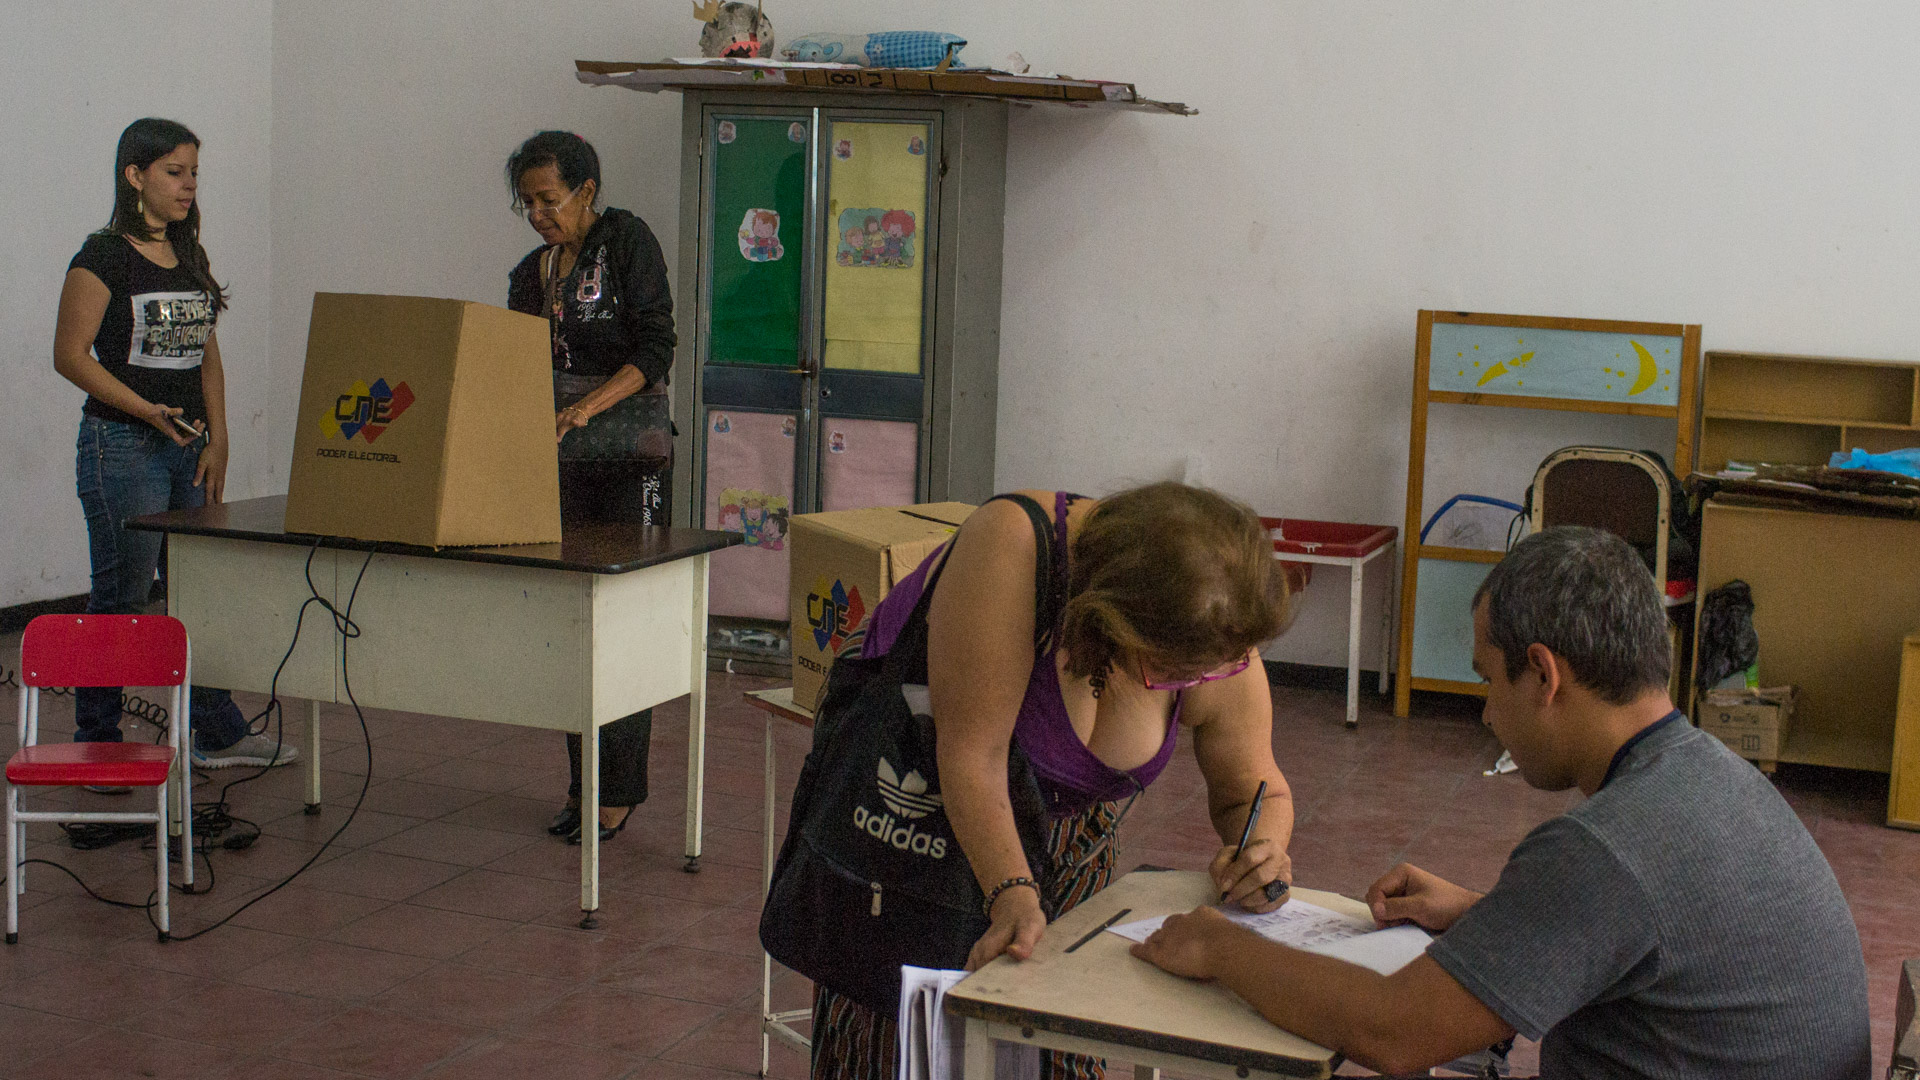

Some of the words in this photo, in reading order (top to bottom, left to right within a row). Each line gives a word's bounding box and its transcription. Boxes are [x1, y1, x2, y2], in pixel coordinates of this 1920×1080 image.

[335, 394, 393, 424] CNE
[316, 448, 347, 459] PODER
[347, 451, 402, 464] ELECTORAL
[806, 592, 851, 638] CNE
[798, 655, 822, 675] PODER
[853, 804, 948, 859] adidas
